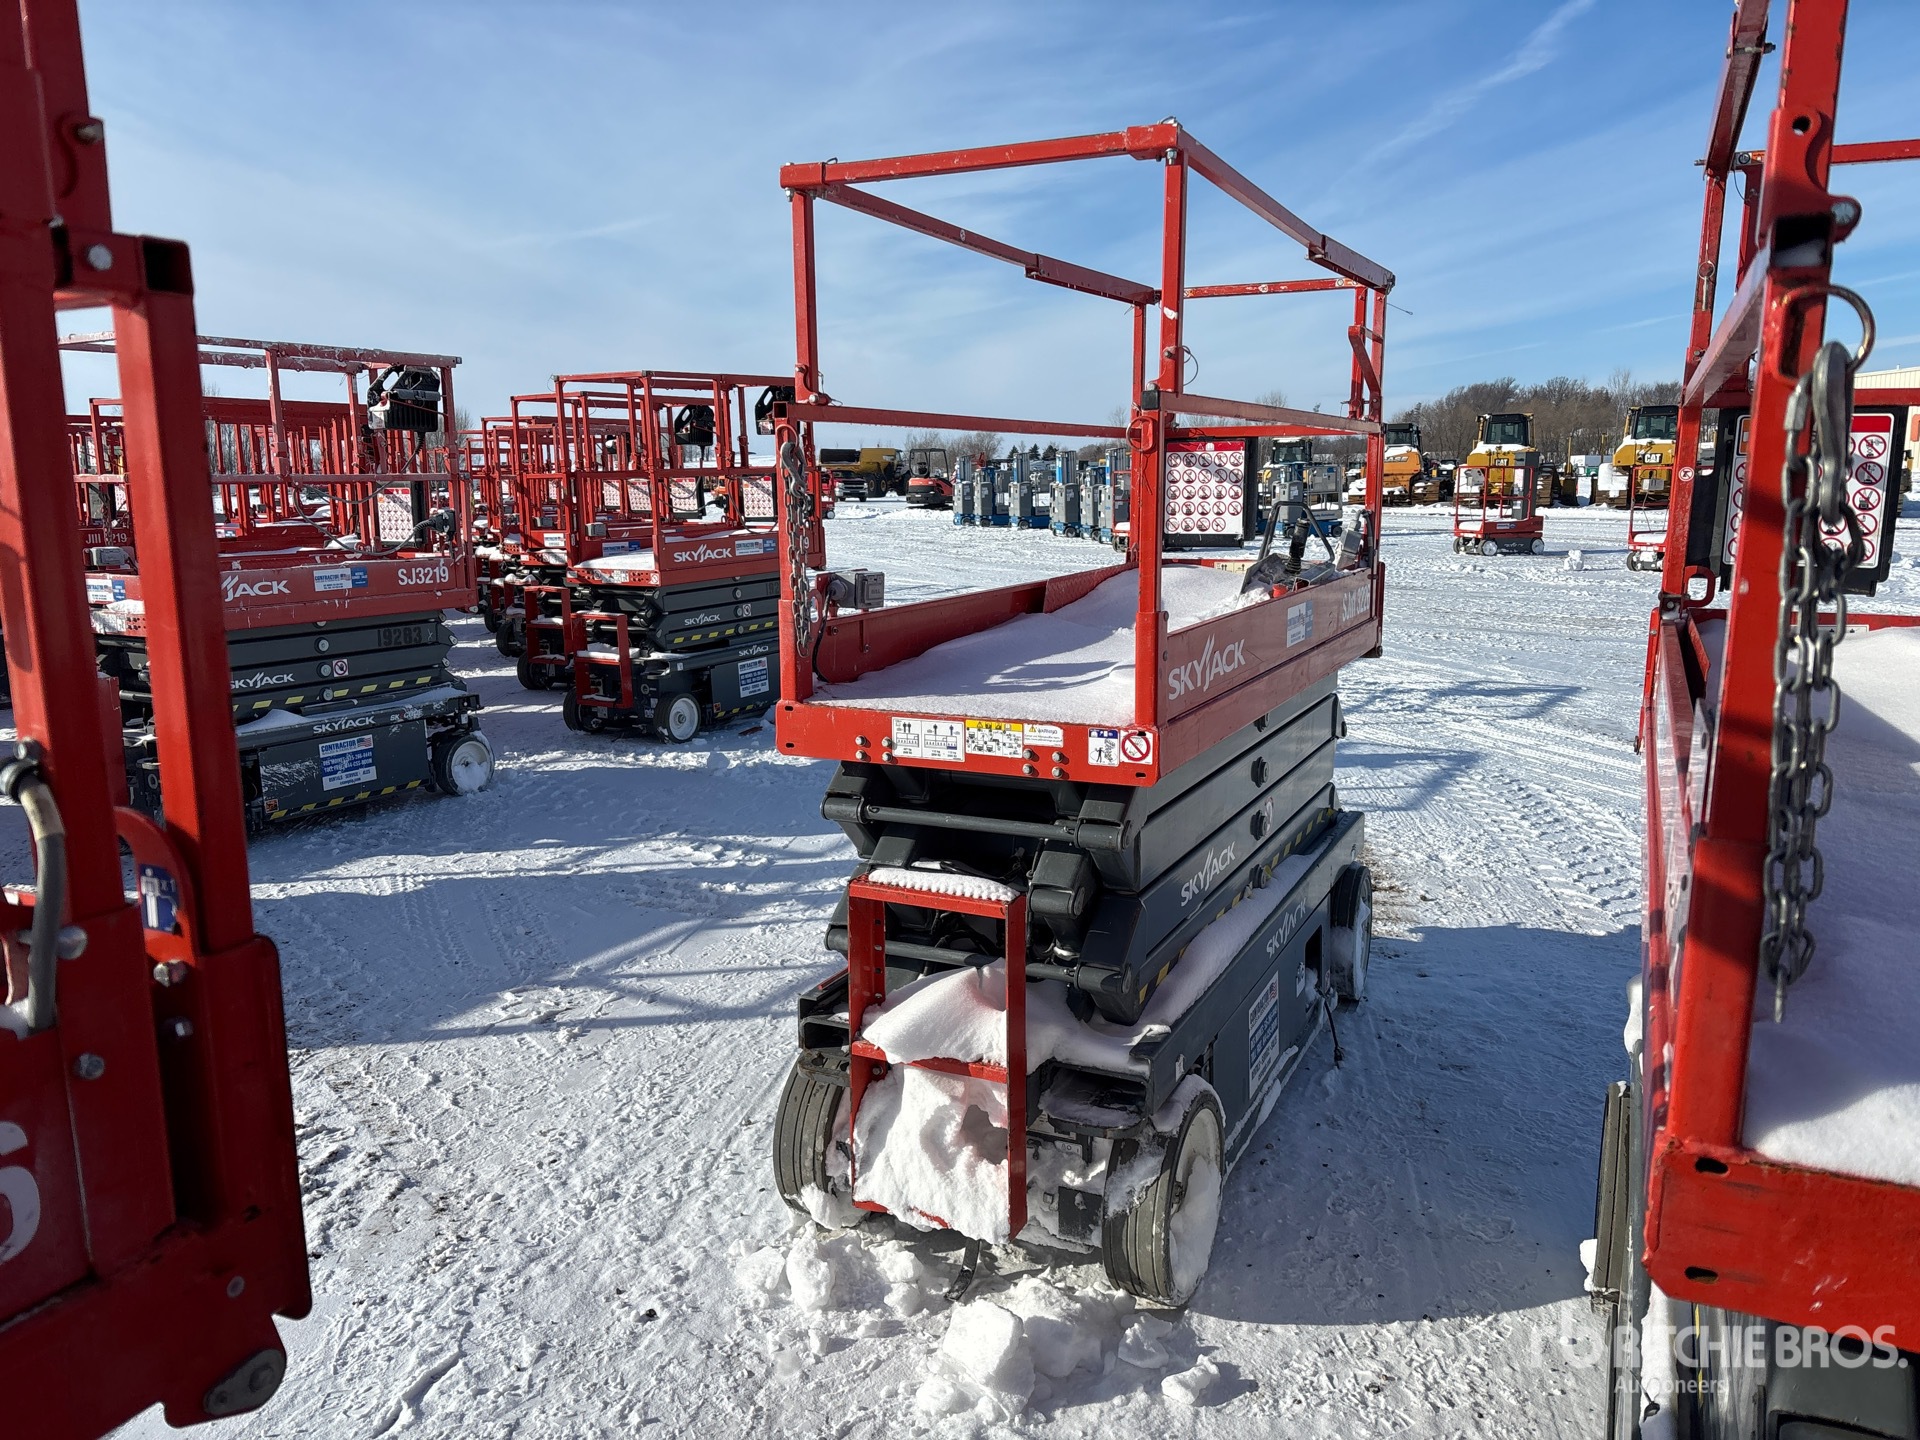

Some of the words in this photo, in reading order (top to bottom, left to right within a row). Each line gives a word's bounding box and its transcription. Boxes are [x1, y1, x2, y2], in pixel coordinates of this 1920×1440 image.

[1644, 453, 1661, 464] CAT
[673, 543, 733, 563] SKYJACK
[397, 566, 449, 586] SJ3219
[222, 574, 291, 602] JACK
[684, 613, 720, 626] SKYJACK
[1167, 633, 1247, 700] SKYJACK
[312, 717, 376, 735] SKYJACK
[321, 740, 356, 753] CONTRACTOR
[1180, 840, 1236, 907] SKYJACK
[1266, 897, 1307, 959] SKYJACK
